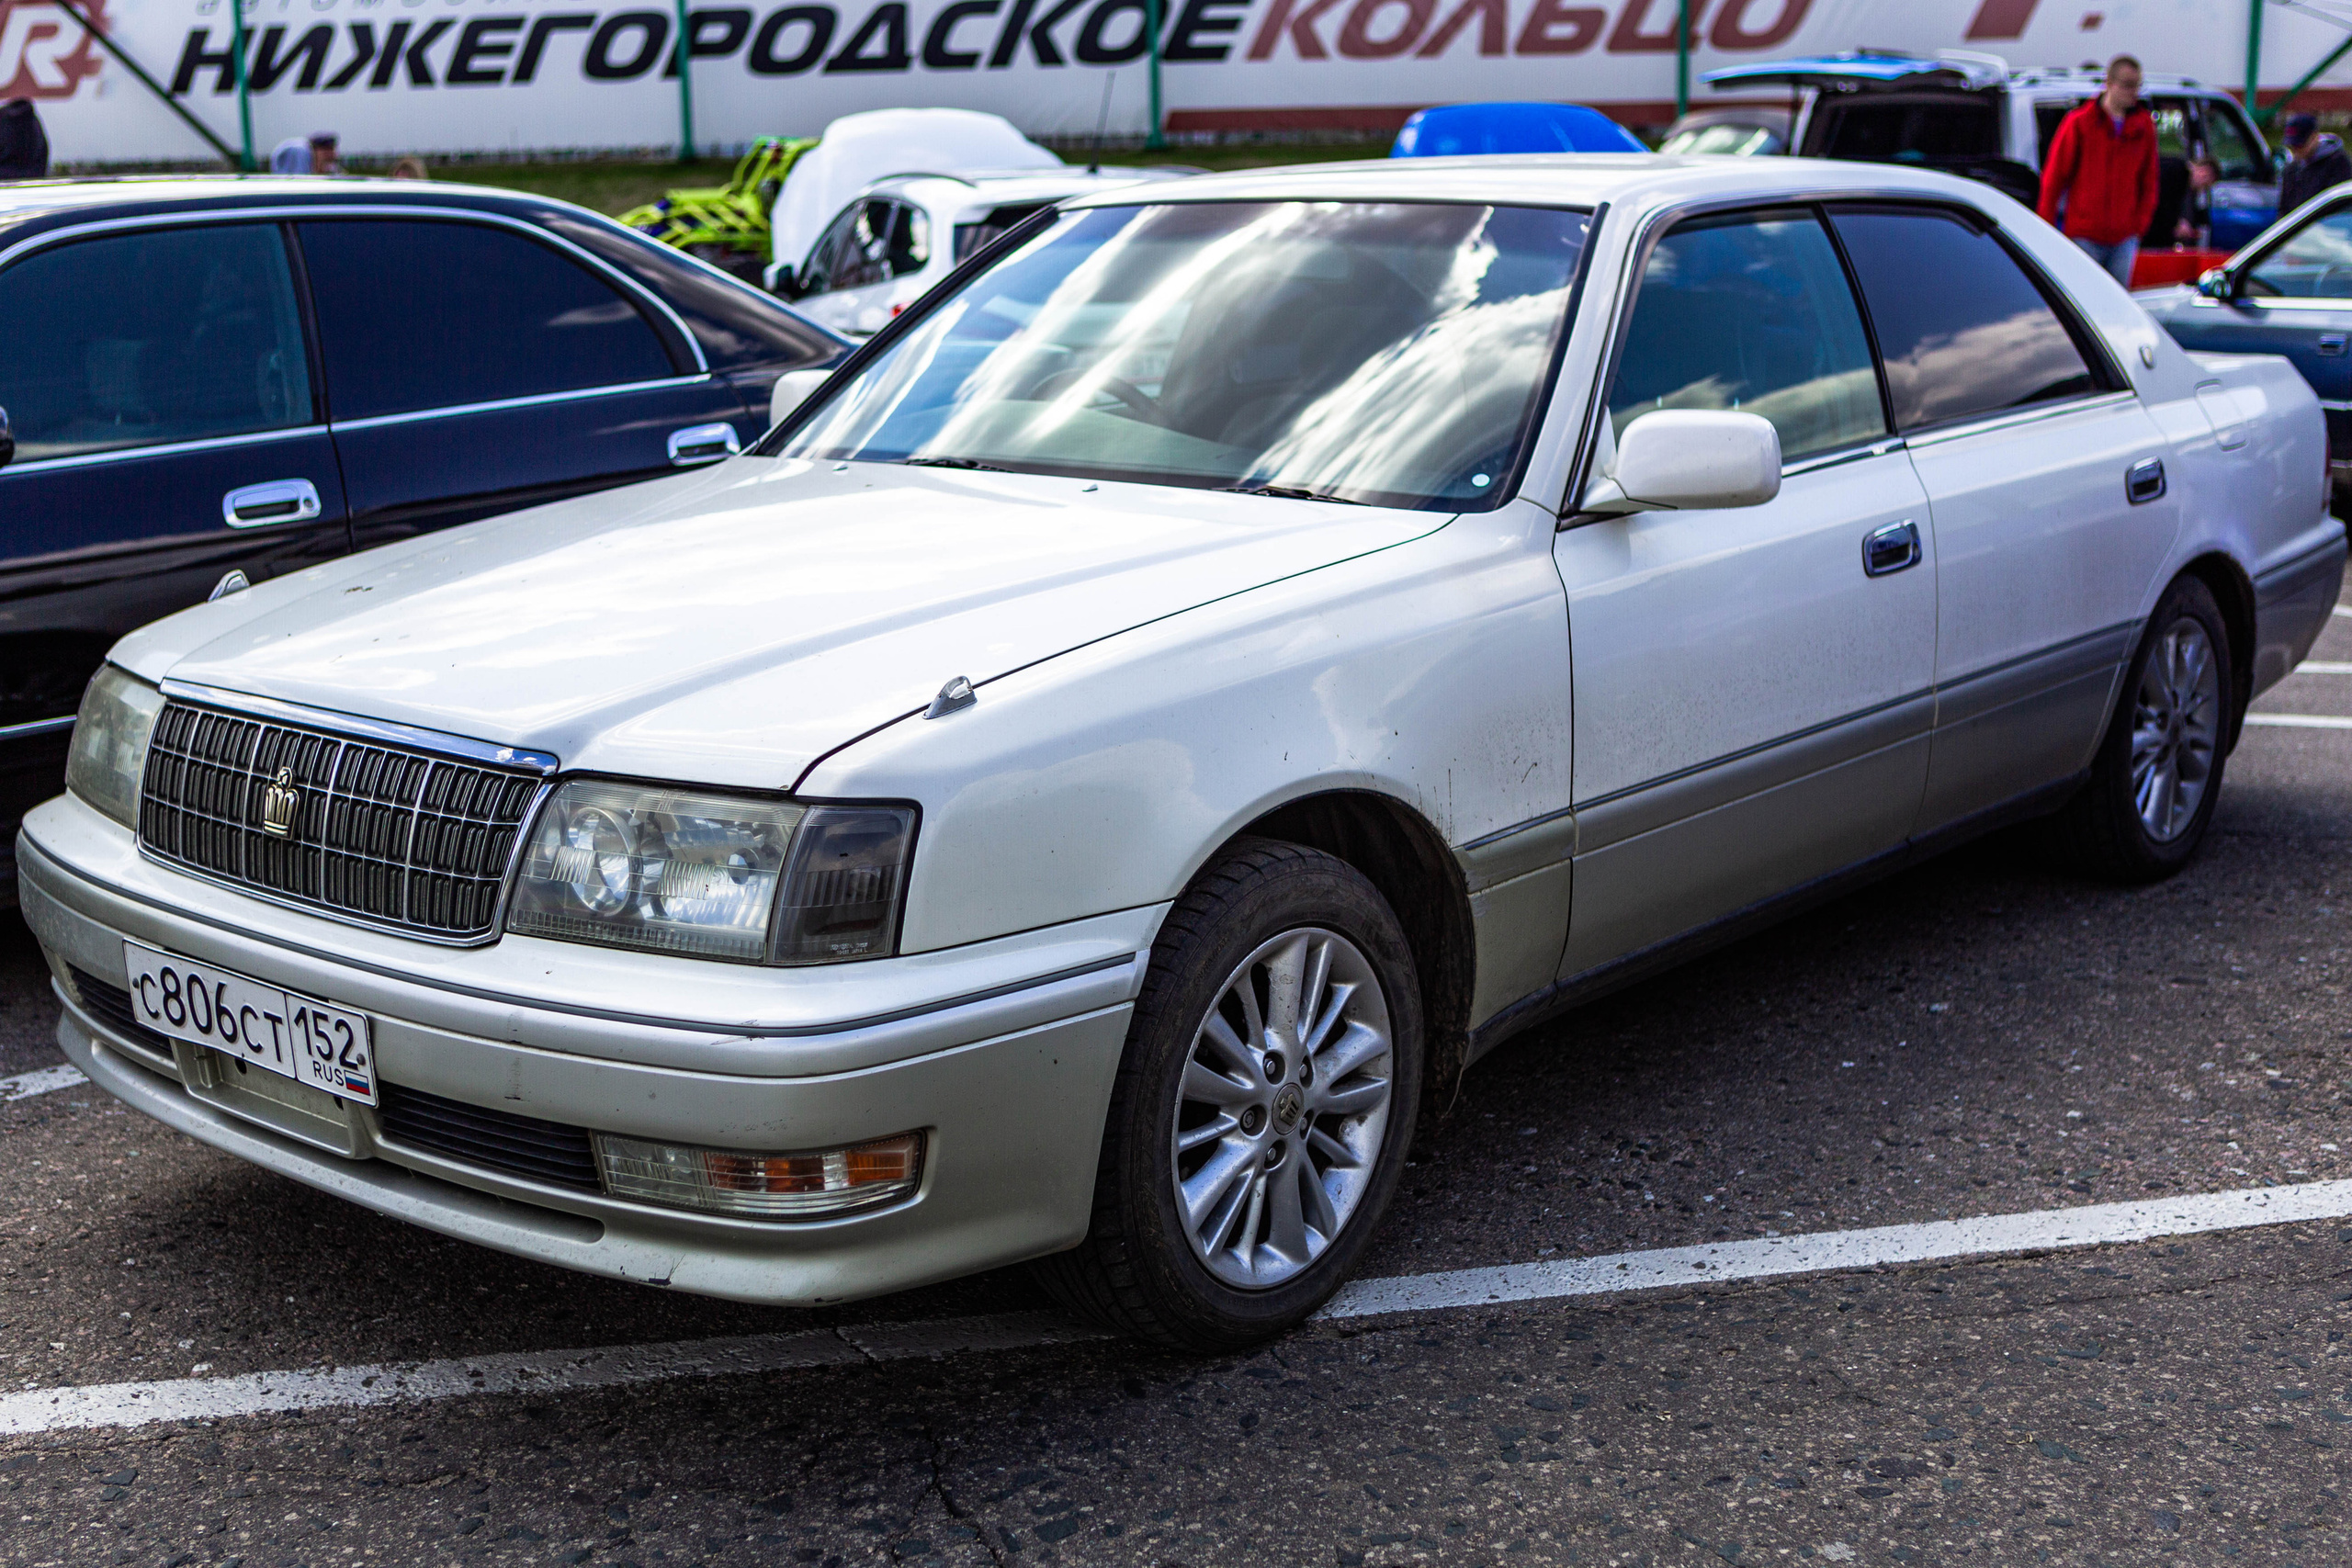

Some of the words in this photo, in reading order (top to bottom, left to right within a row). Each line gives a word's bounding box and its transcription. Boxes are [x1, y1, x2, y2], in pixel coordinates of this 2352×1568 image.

[171, 0, 1255, 94] НИЖЕГОРОДСКОЕ
[1247, 0, 1812, 61] КОЛЬЦО
[294, 1005, 358, 1071] 152
[312, 1059, 345, 1087] RUS
